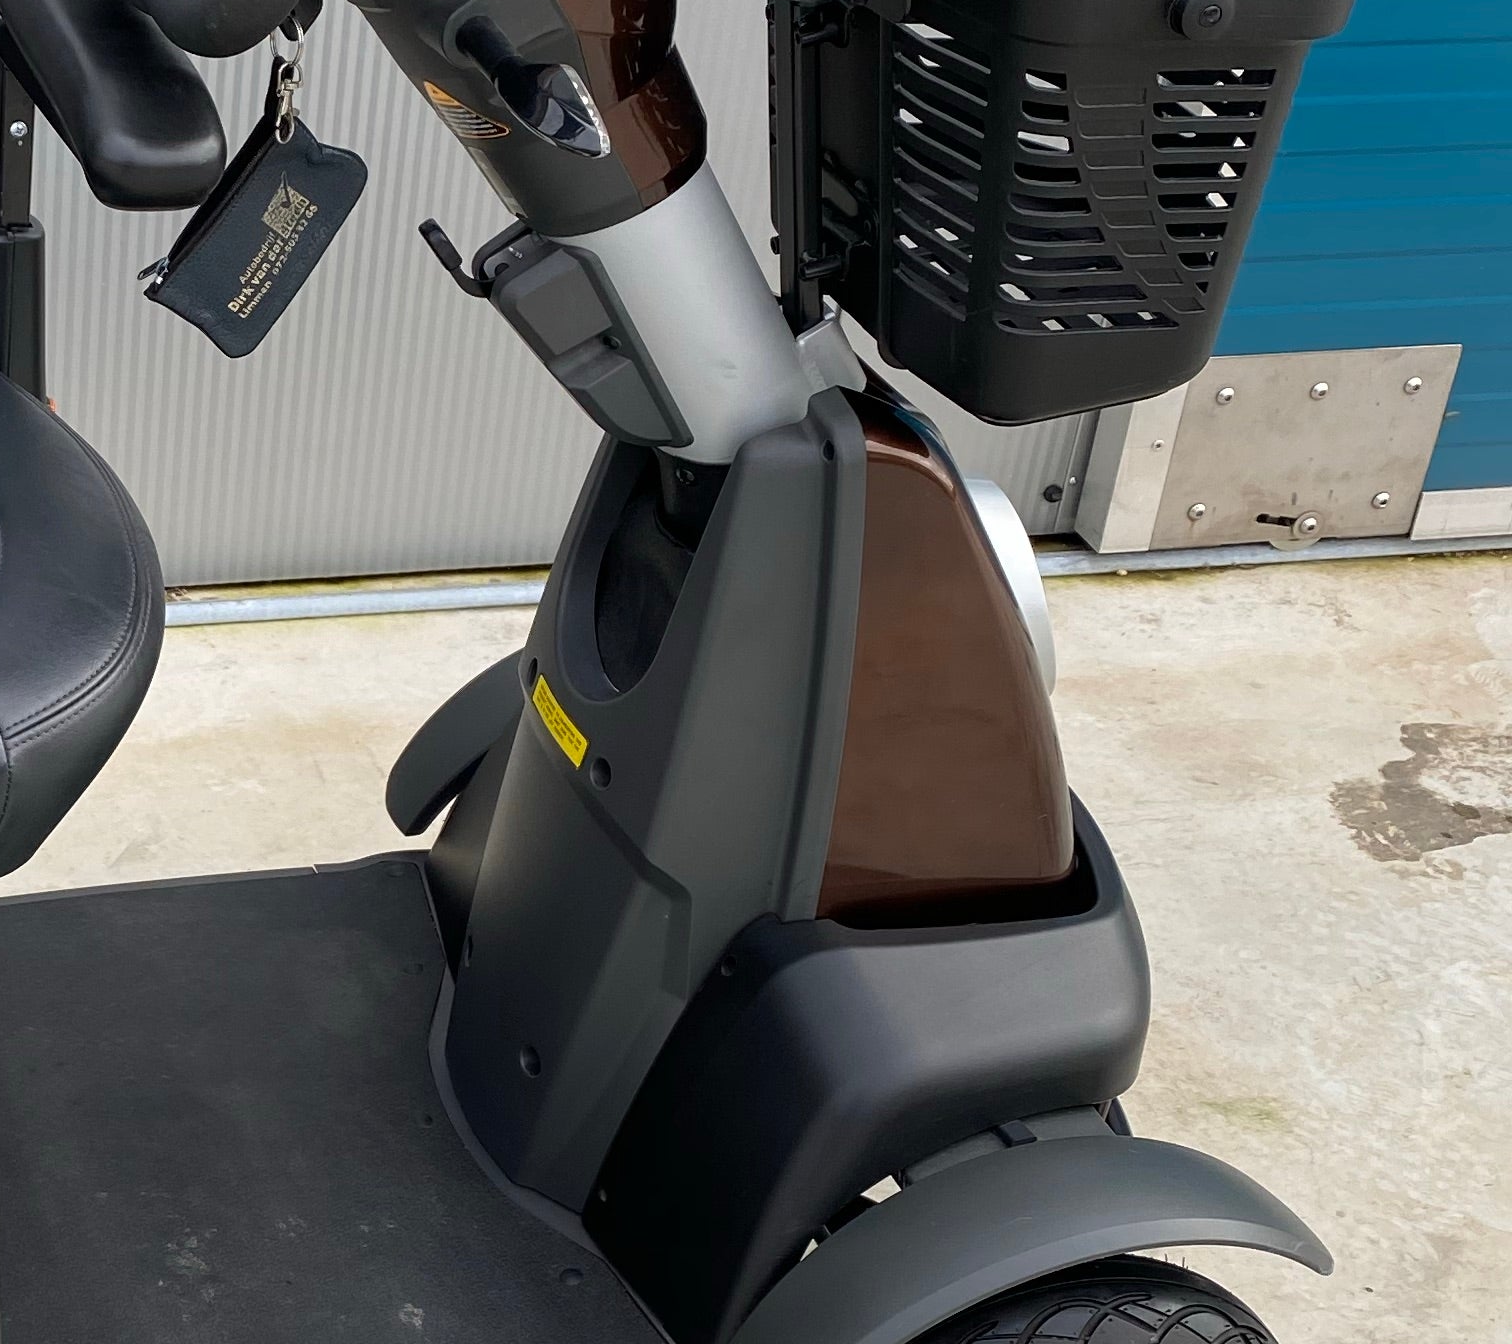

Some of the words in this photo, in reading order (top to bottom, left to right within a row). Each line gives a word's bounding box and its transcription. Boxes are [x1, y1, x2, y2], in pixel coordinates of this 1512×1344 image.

[228, 285, 255, 313] Dirk
[251, 262, 271, 285] van
[268, 239, 284, 262] der
[238, 280, 273, 319] Limmen
